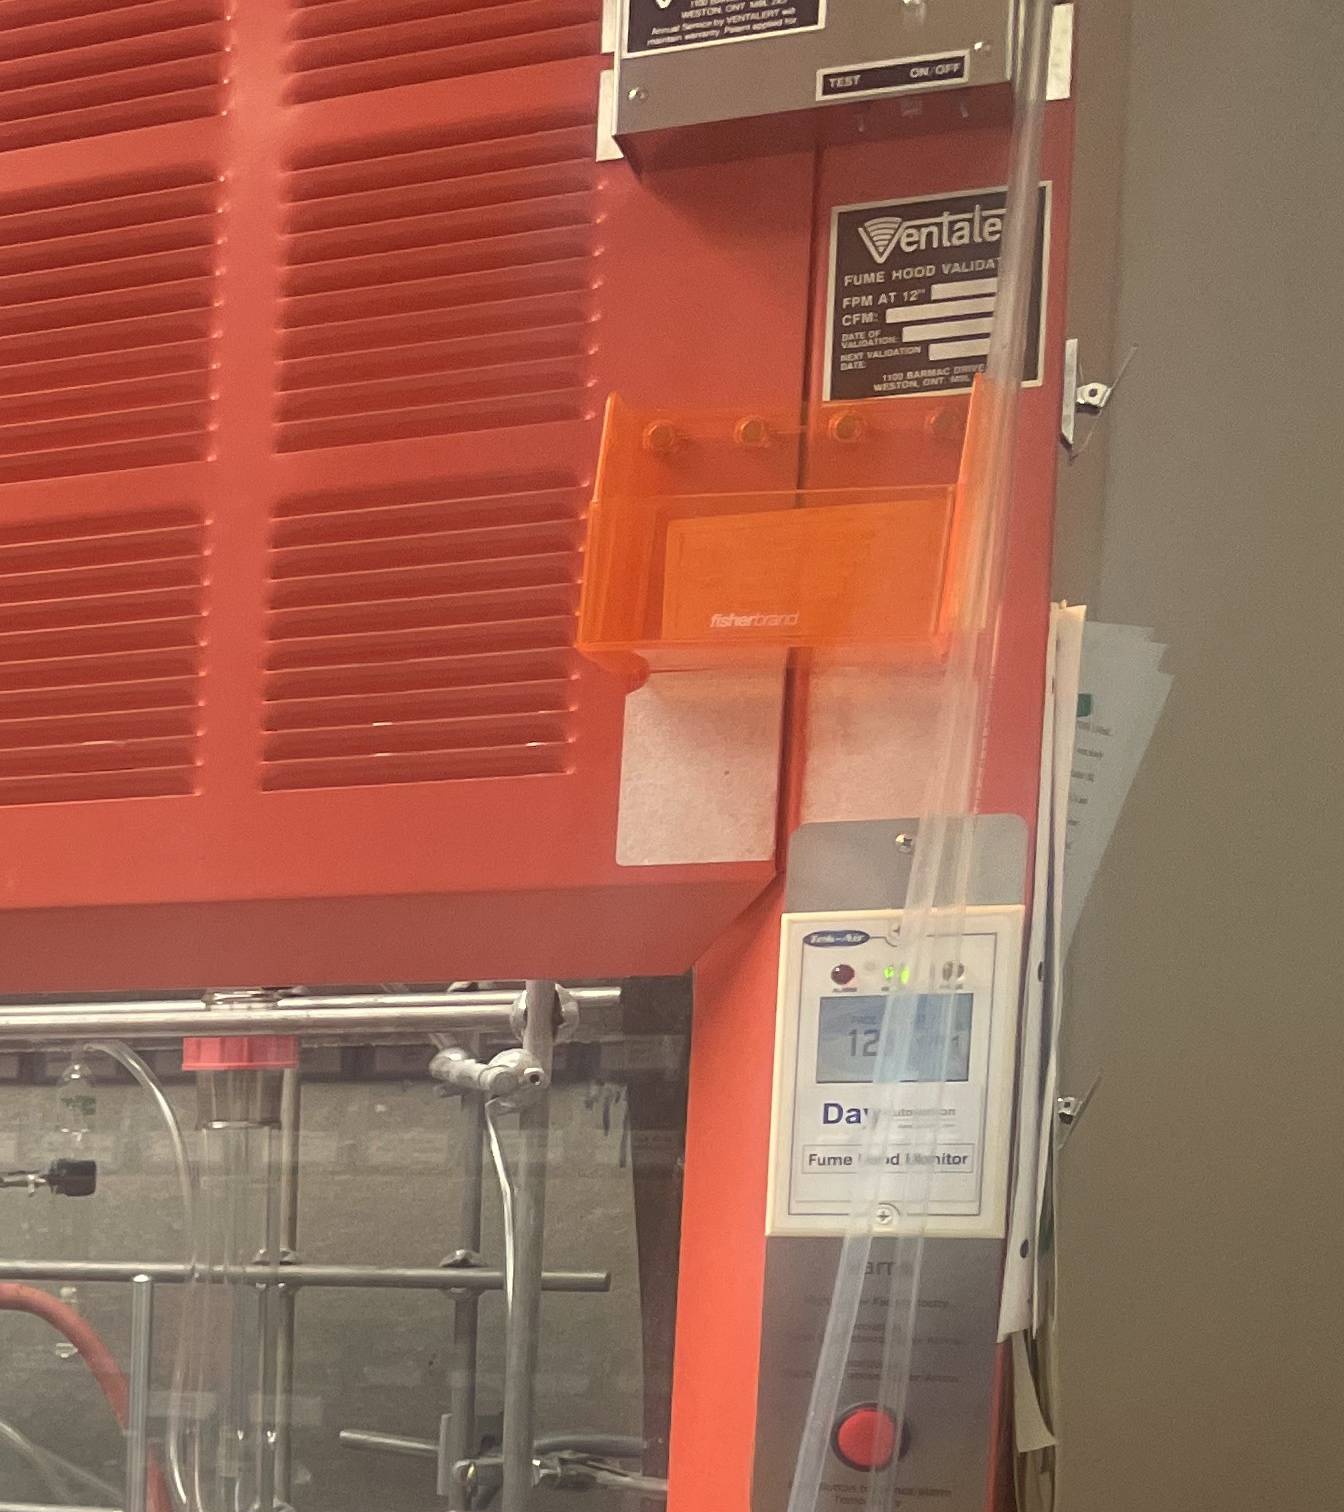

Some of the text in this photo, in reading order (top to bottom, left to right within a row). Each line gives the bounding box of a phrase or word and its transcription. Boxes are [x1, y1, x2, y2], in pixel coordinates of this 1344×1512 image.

[828, 73, 861, 88] TEST
[844, 256, 1002, 287] FUME HOOD VALIDAT
[842, 295, 873, 309] FPM
[877, 291, 897, 305] AT
[841, 328, 881, 342] DATE OF
[840, 345, 922, 362] NEXT VALIDATION
[906, 365, 950, 380] BARMAC
[710, 610, 800, 628] fisherbrand
[808, 1153, 853, 1167] Fume
